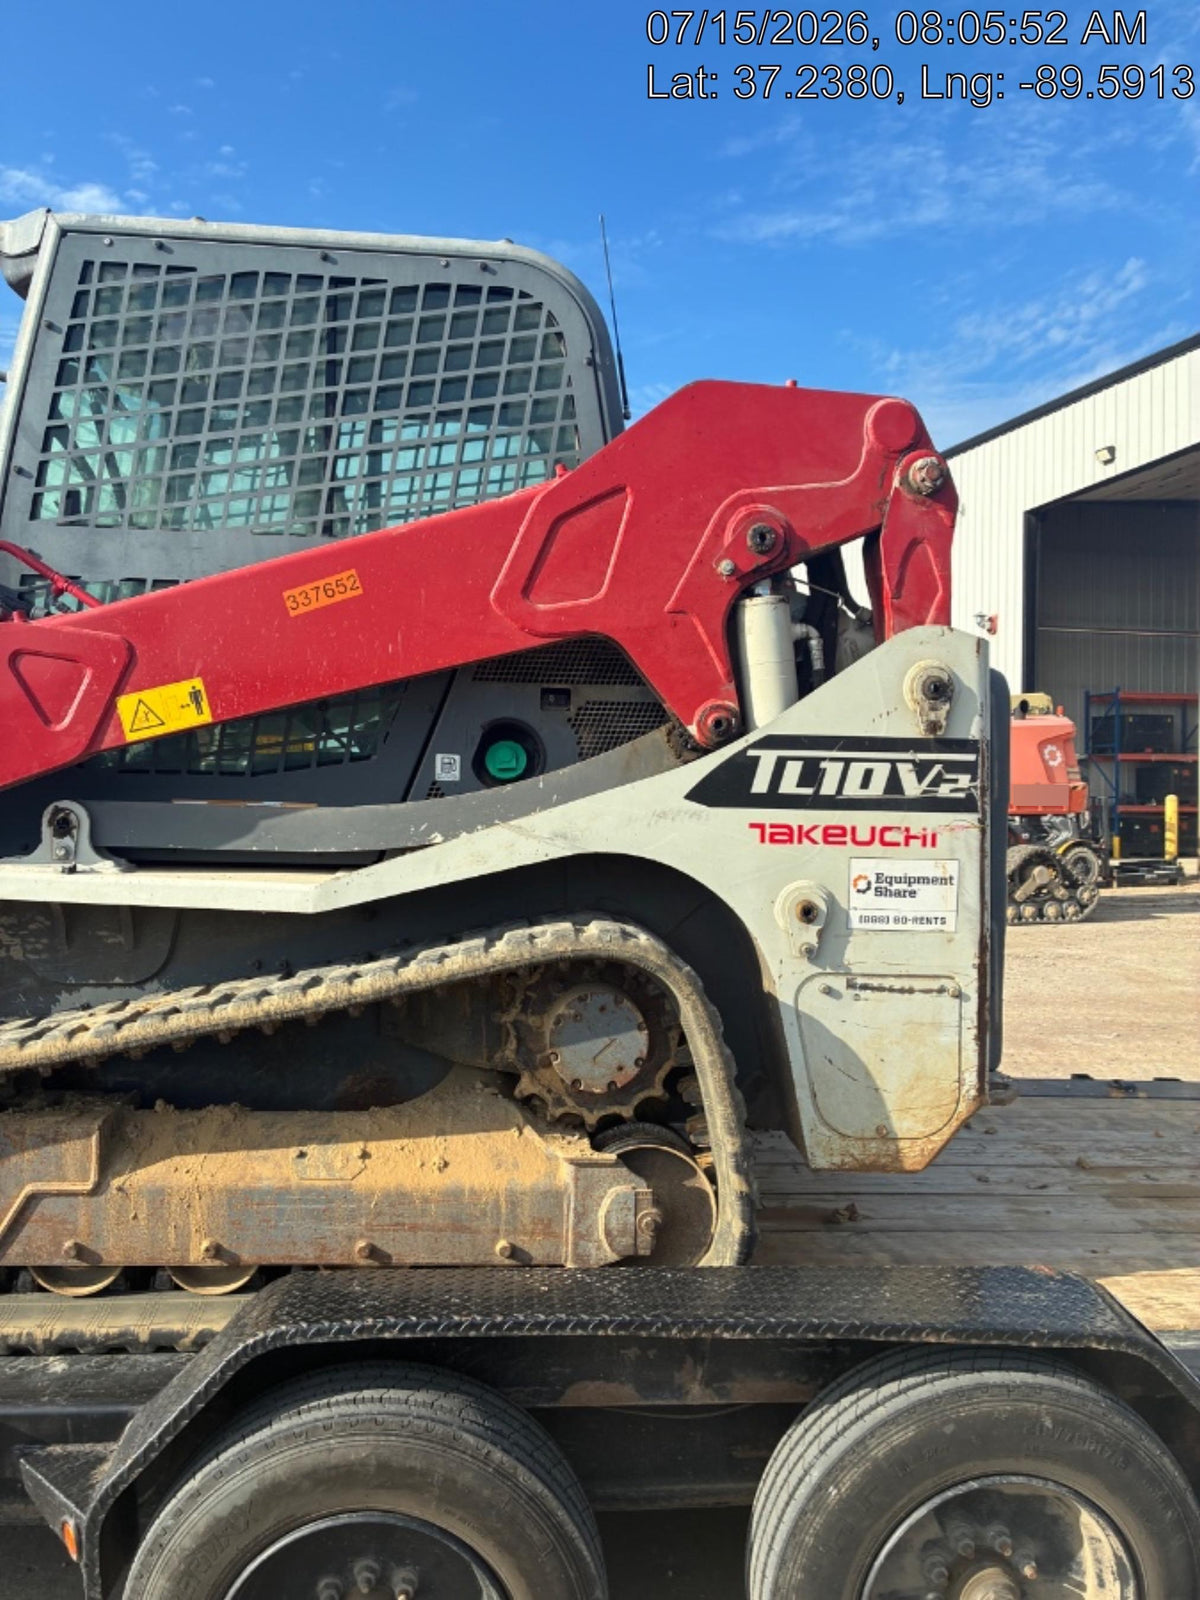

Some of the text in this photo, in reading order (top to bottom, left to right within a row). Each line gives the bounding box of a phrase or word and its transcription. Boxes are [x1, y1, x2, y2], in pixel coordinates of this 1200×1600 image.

[286, 573, 360, 611] 337652
[874, 872, 954, 887] Equipment
[874, 886, 917, 898] Share
